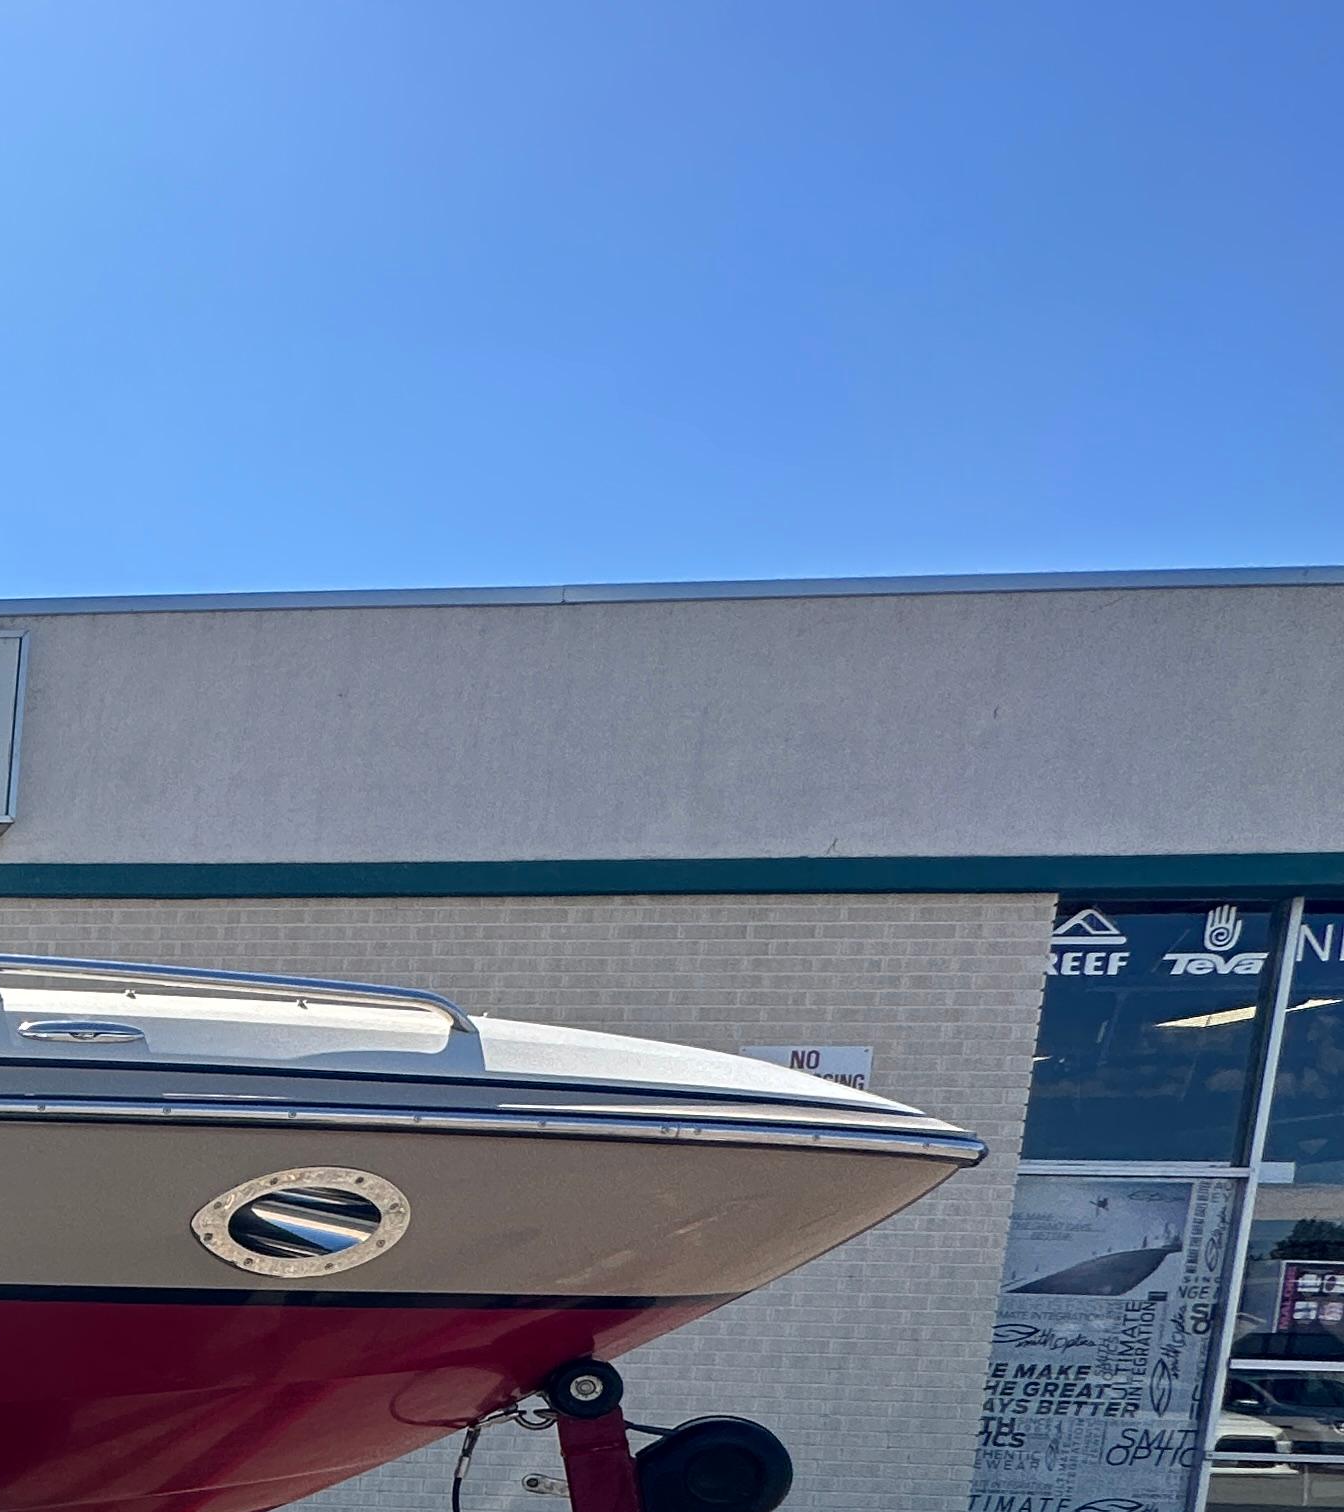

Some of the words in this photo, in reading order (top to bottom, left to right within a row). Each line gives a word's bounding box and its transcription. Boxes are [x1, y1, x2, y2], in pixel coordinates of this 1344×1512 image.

[790, 1050, 821, 1069] NO
[1112, 1301, 1141, 1400] ULTIMATE
[1127, 1301, 1157, 1401] INTEGRATION
[1013, 1363, 1092, 1381] MAKE
[1022, 1381, 1112, 1399] GREAT
[1035, 1400, 1140, 1418] BETTER
